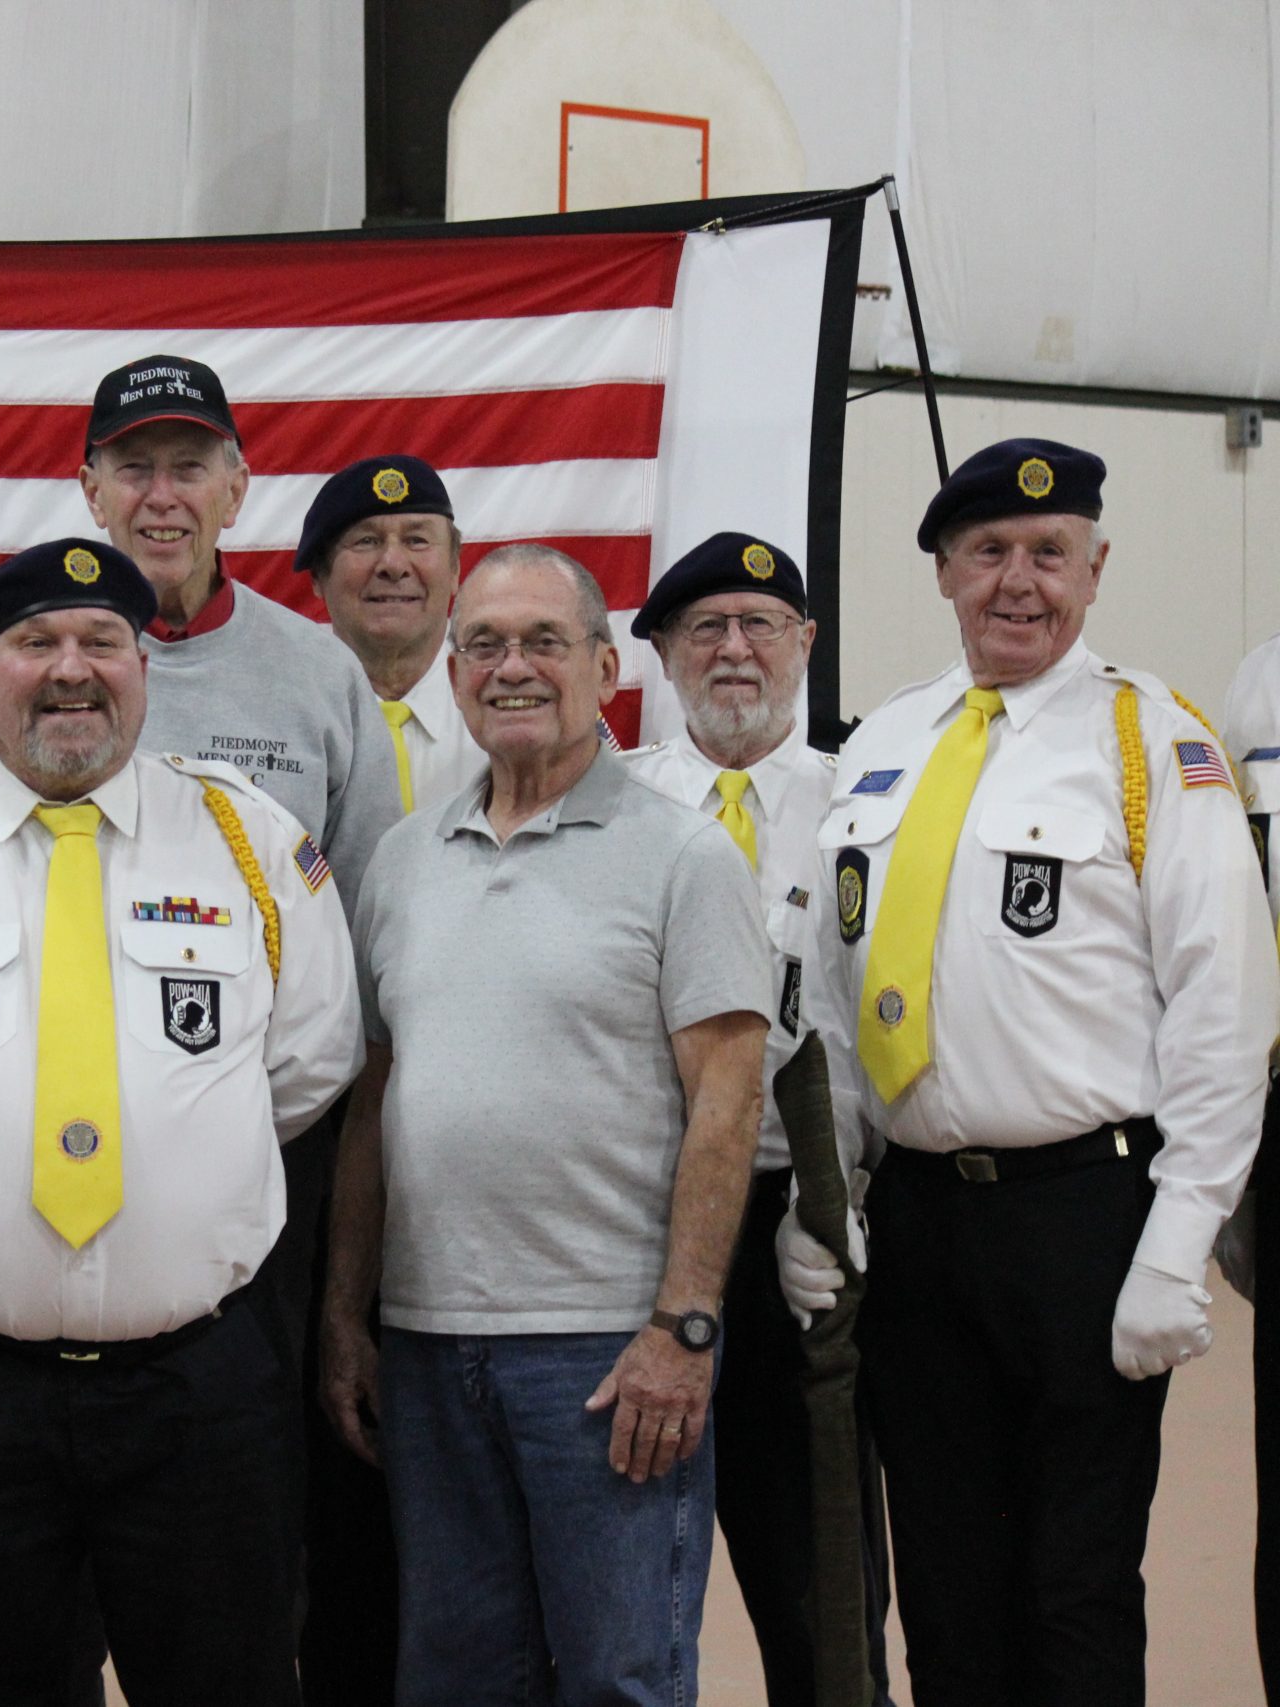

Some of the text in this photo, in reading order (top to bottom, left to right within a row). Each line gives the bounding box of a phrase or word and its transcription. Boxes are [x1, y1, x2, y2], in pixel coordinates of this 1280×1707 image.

[129, 367, 190, 386] PIEDMONT
[120, 389, 143, 406] MEN
[147, 385, 162, 395] OF
[211, 736, 287, 754] PIEDMONT
[234, 755, 253, 767] OF
[1012, 862, 1051, 889] POW MIA
[169, 982, 212, 1016] POW MIA
